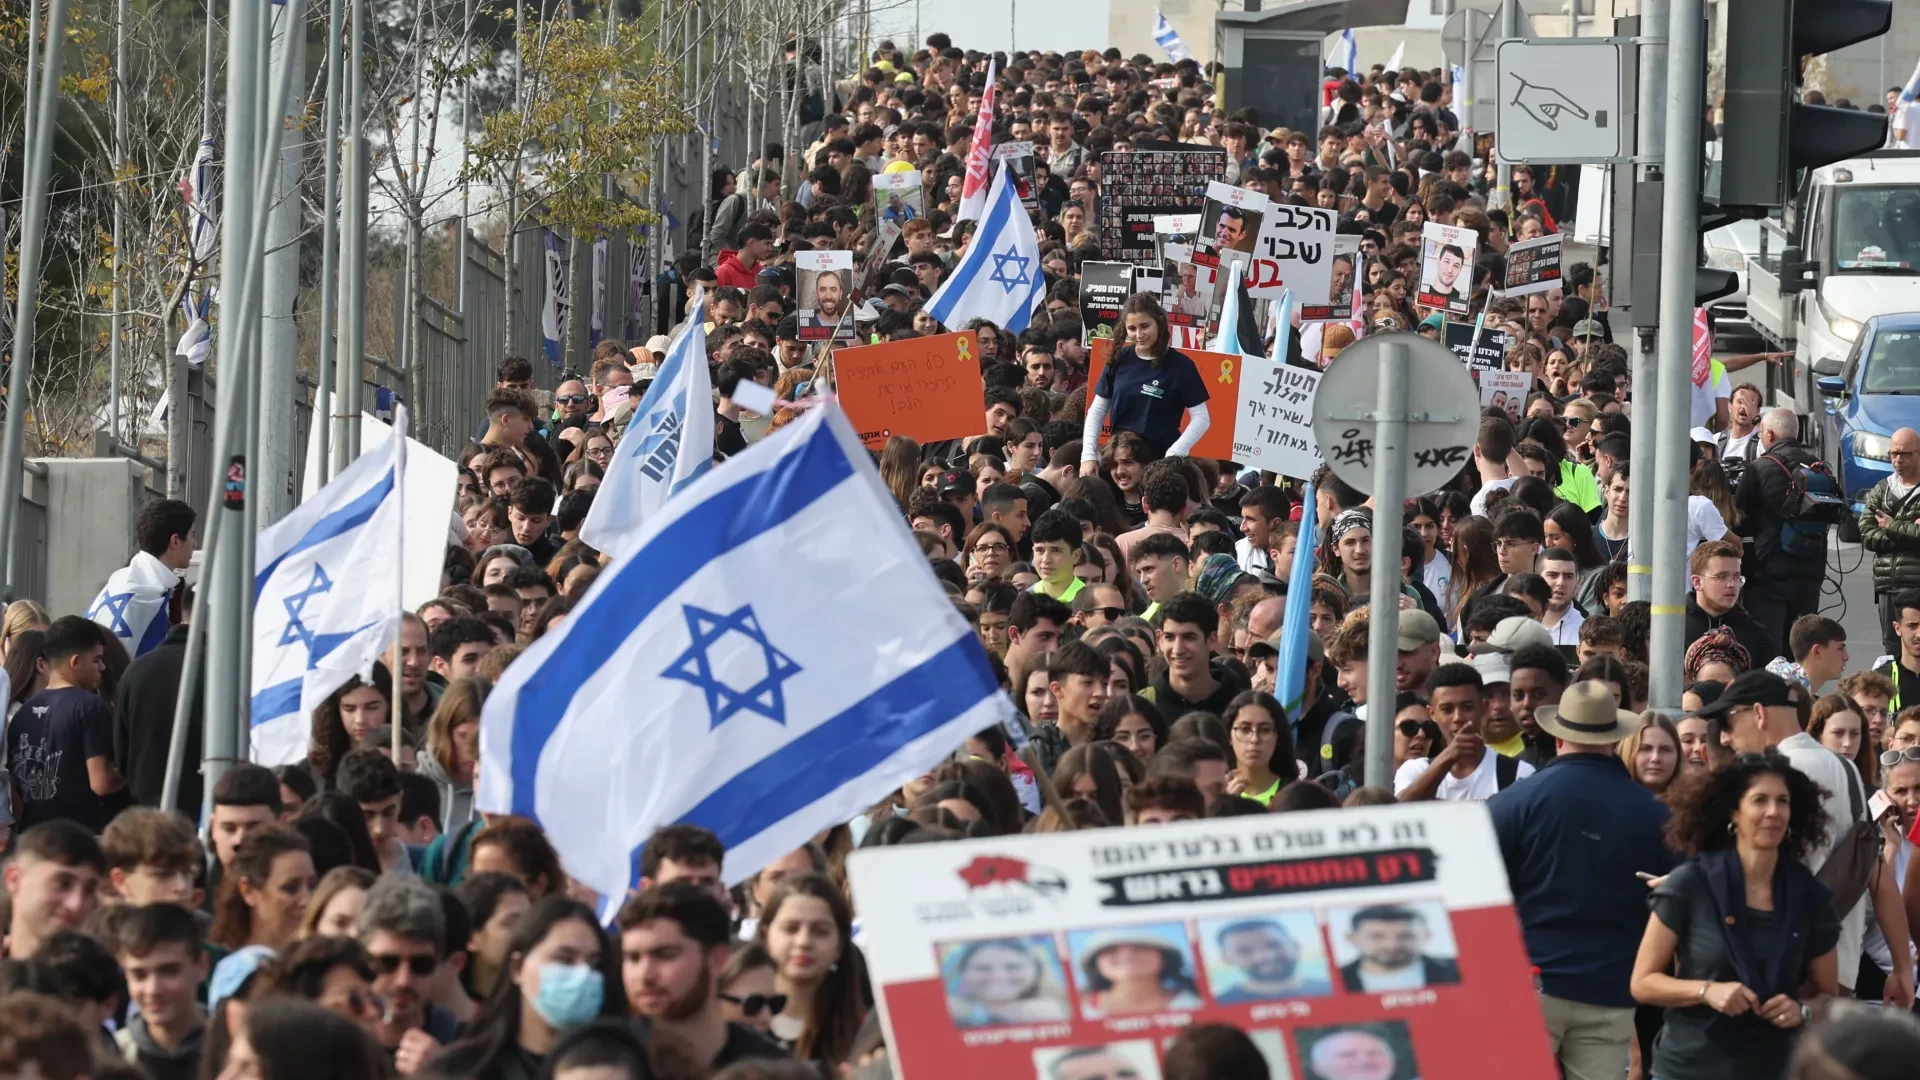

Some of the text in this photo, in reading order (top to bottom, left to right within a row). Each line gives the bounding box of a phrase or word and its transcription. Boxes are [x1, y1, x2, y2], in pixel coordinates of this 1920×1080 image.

[1275, 207, 1331, 232] הלב
[1264, 236, 1322, 264] שבוי
[926, 350, 944, 370] כל
[1451, 344, 1501, 358] איבדנו ספיק.
[655, 411, 678, 433] עד
[1253, 825, 1327, 852] שלם
[1337, 822, 1379, 845] לא
[1393, 818, 1428, 842] זה
[1121, 853, 1422, 903] רק החטופים בראש
